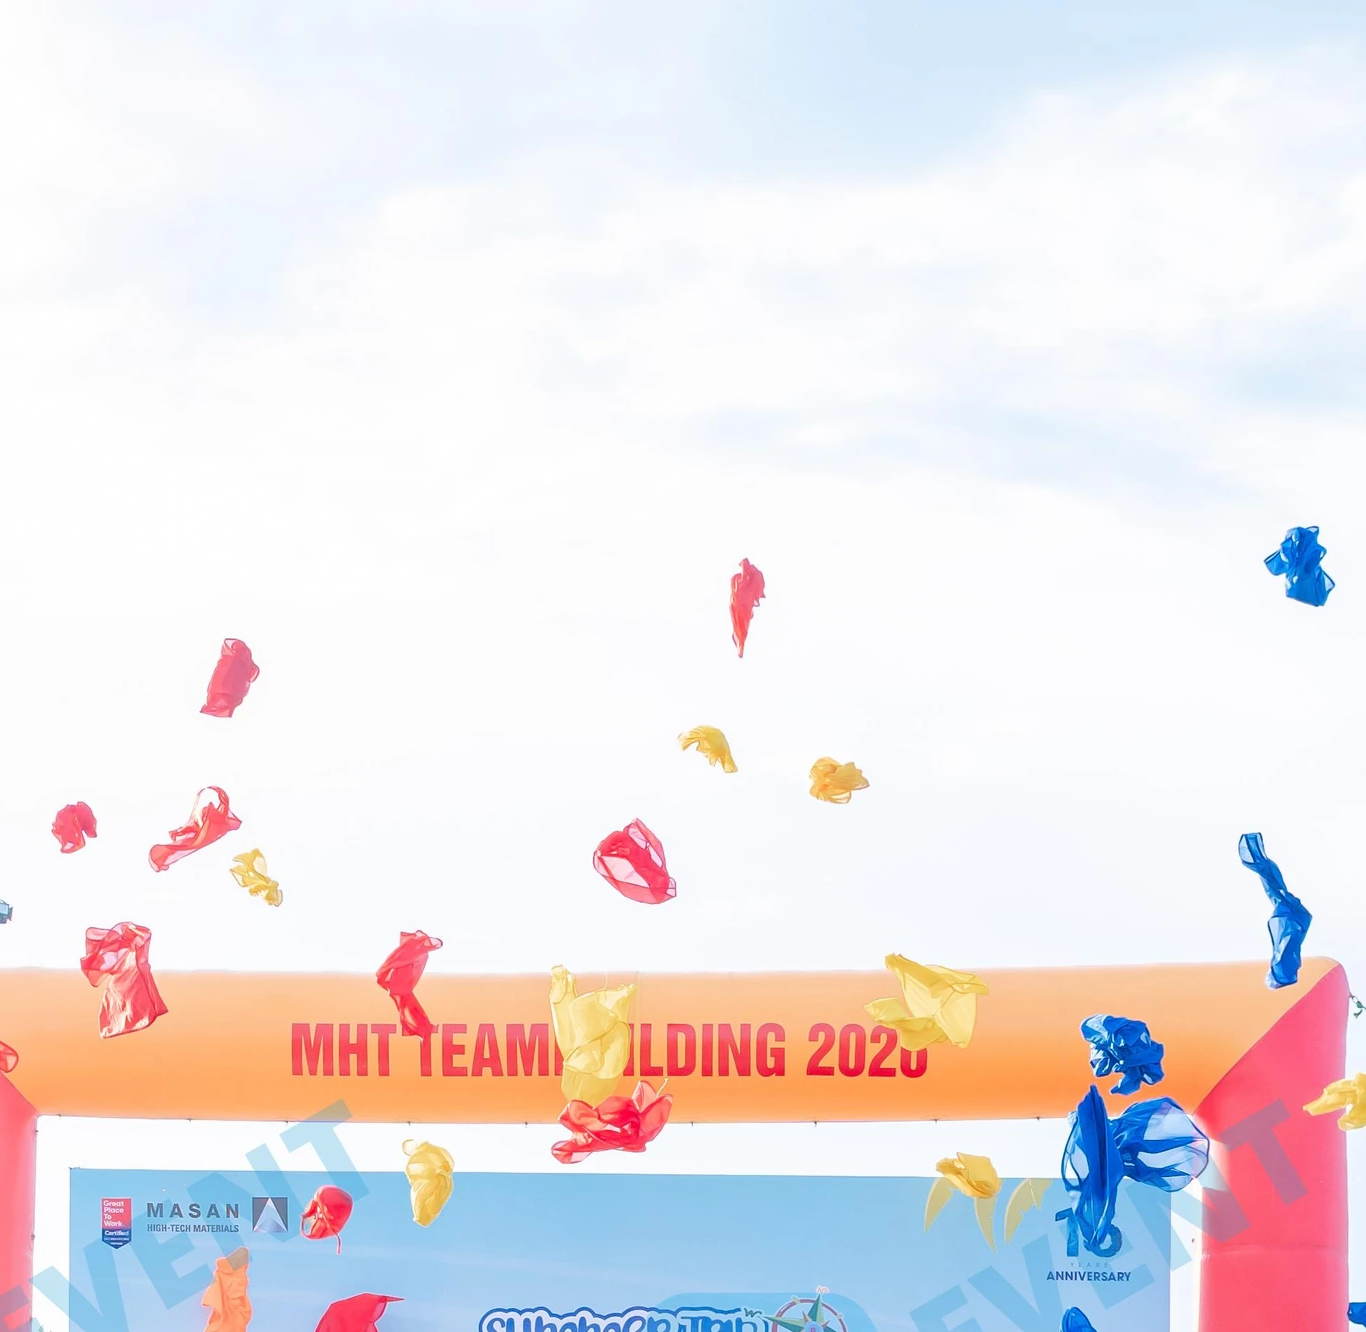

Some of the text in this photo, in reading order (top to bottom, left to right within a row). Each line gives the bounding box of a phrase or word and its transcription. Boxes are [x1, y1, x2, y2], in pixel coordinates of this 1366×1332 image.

[292, 1023, 396, 1076] MHT
[402, 1023, 786, 1077] TEAMILDING
[147, 1202, 240, 1218] MASAN
[147, 1224, 239, 1233] HIGH-TECH MATERIALS
[1046, 1271, 1131, 1282] ANNIVERSARY
